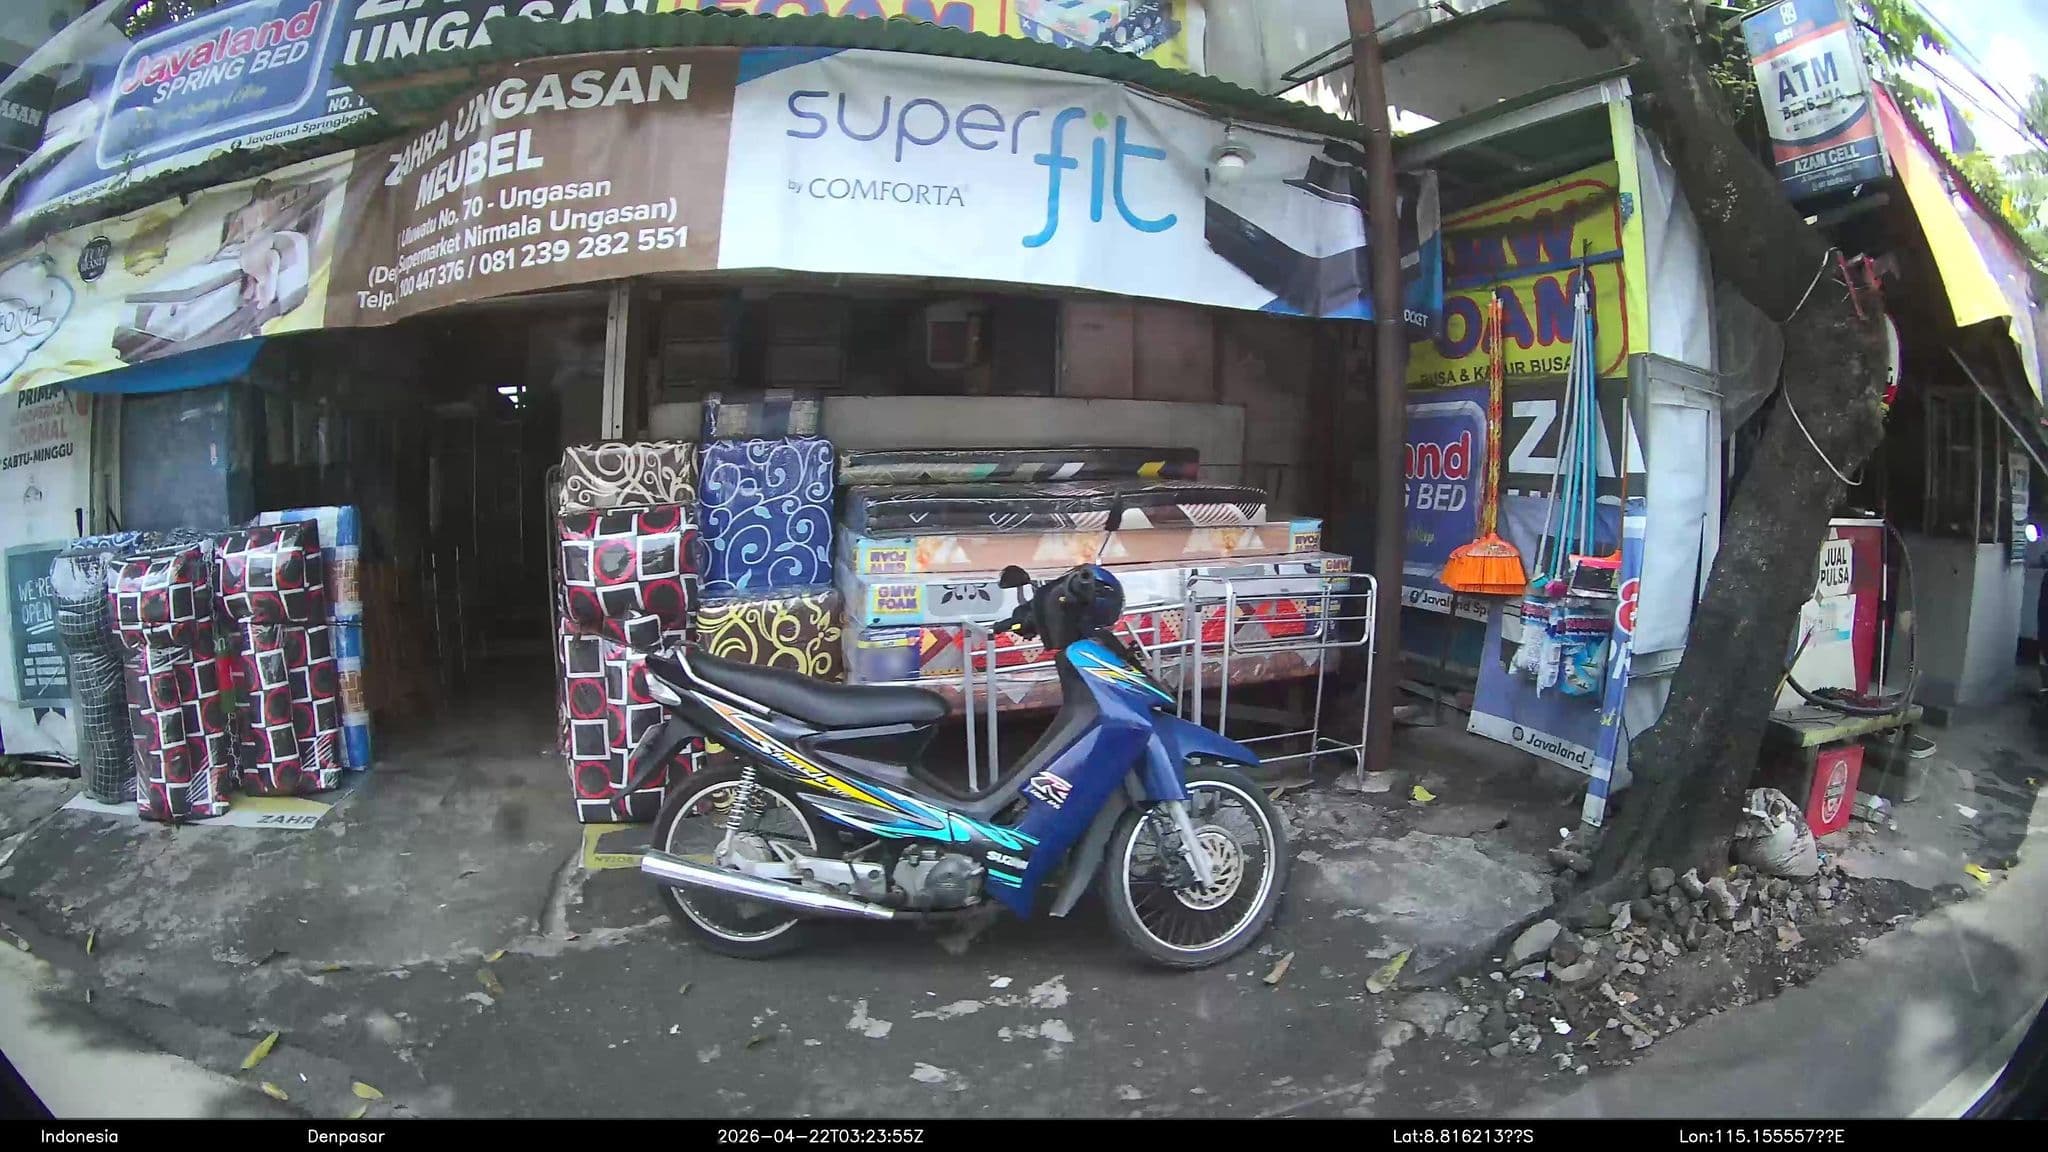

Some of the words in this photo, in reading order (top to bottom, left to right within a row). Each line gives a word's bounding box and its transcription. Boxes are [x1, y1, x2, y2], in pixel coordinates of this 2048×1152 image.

[121, 0, 322, 95] Javaland
[153, 57, 245, 104] SPRING
[249, 41, 309, 74] BED
[1778, 51, 1839, 103] ATM
[328, 96, 353, 113] NO.
[246, 126, 299, 146] Javaland
[384, 119, 450, 186] ZAHRA
[453, 63, 692, 142] UNGASAN
[414, 129, 544, 211] MEUBEL
[1794, 152, 1828, 174] AZAM
[1828, 143, 1861, 164] CELL
[438, 208, 460, 230] No.
[462, 196, 484, 221] 70
[499, 178, 612, 212] Ungasan
[787, 179, 802, 194] by
[808, 177, 966, 207] COMFORTA
[399, 233, 462, 274] Supermarket
[463, 214, 542, 250] Nirmala
[549, 198, 678, 234] Ungasan)
[357, 289, 395, 311] Telp.
[415, 267, 437, 291] 447
[437, 258, 465, 285] 376
[479, 247, 516, 275] 081
[520, 239, 571, 268] 239
[576, 231, 630, 259] 282
[637, 225, 689, 250] 551
[1459, 368, 1471, 382] &
[1473, 361, 1527, 381] KAUR
[2, 442, 74, 470] SABTU-MINGGU
[1416, 483, 1467, 512] BED
[1824, 547, 1848, 567] JUAL
[18, 576, 52, 601] WE'RE
[1820, 568, 1849, 586] PULSA
[877, 586, 917, 598] GMW
[877, 598, 918, 609] FOAM
[1421, 592, 1470, 612] Javalnd
[22, 601, 52, 625] OPEN
[256, 815, 318, 824] ZAHR
